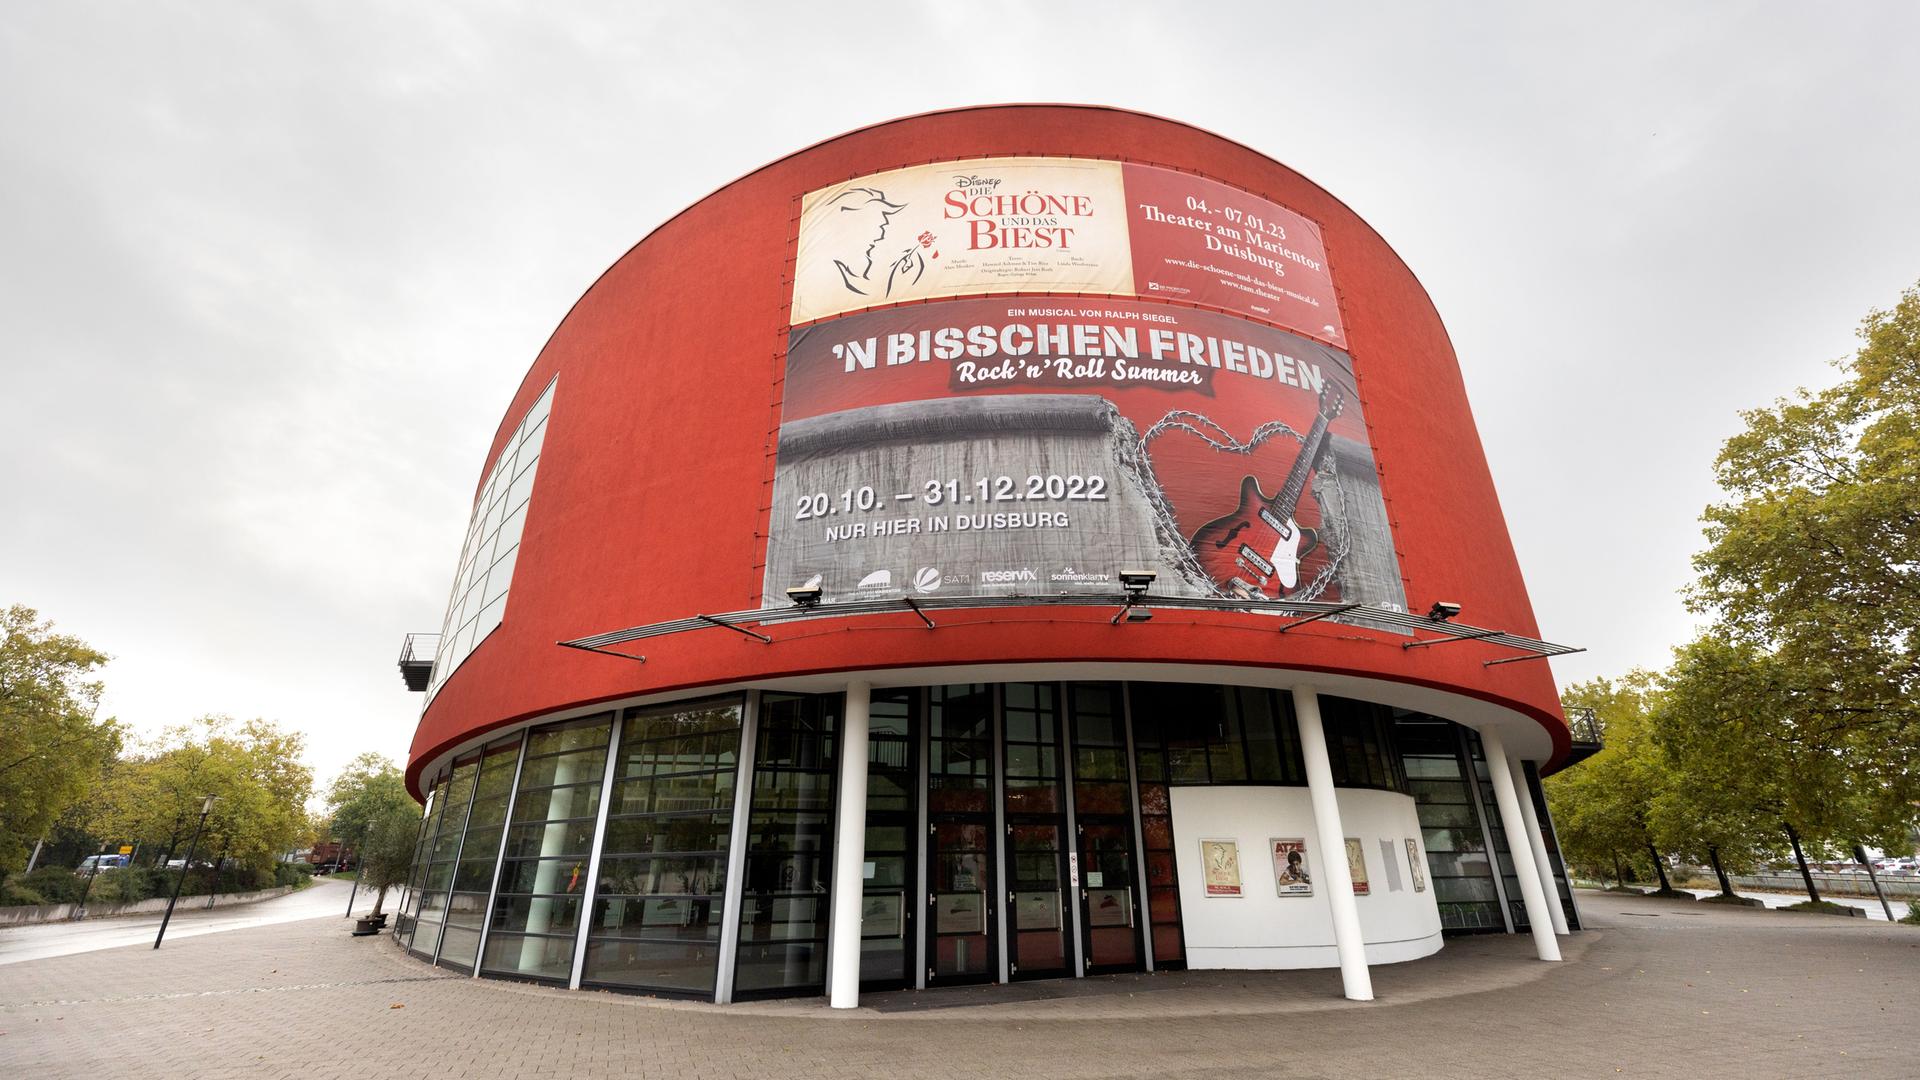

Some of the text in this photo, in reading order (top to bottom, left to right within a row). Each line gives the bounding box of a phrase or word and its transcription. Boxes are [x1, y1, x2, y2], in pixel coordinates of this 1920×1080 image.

[952, 175, 1001, 189] Disney
[970, 187, 992, 196] DIE
[944, 189, 1094, 219] SCHÖNE
[967, 219, 1075, 251] BIEST
[1001, 217, 1057, 226] UND DAS
[1225, 206, 1286, 240] 07.01.23
[1140, 204, 1321, 272] Theater am Marientor
[1204, 234, 1285, 277] Duisburg
[1220, 278, 1281, 302] www.tam.theater
[1007, 308, 1179, 325] EIN MUSICAL VON RALPH SIEGEL
[887, 324, 1139, 366] BISSCHEN
[1149, 328, 1323, 394] FRIEDEN
[1111, 359, 1203, 385] Summer
[795, 486, 883, 520] 20.10.
[924, 475, 1107, 504] 31.12.2022
[826, 511, 1069, 542] NUR HIER IN DUISBURG
[981, 567, 1039, 586] reservix
[1275, 841, 1305, 853] ATZE
